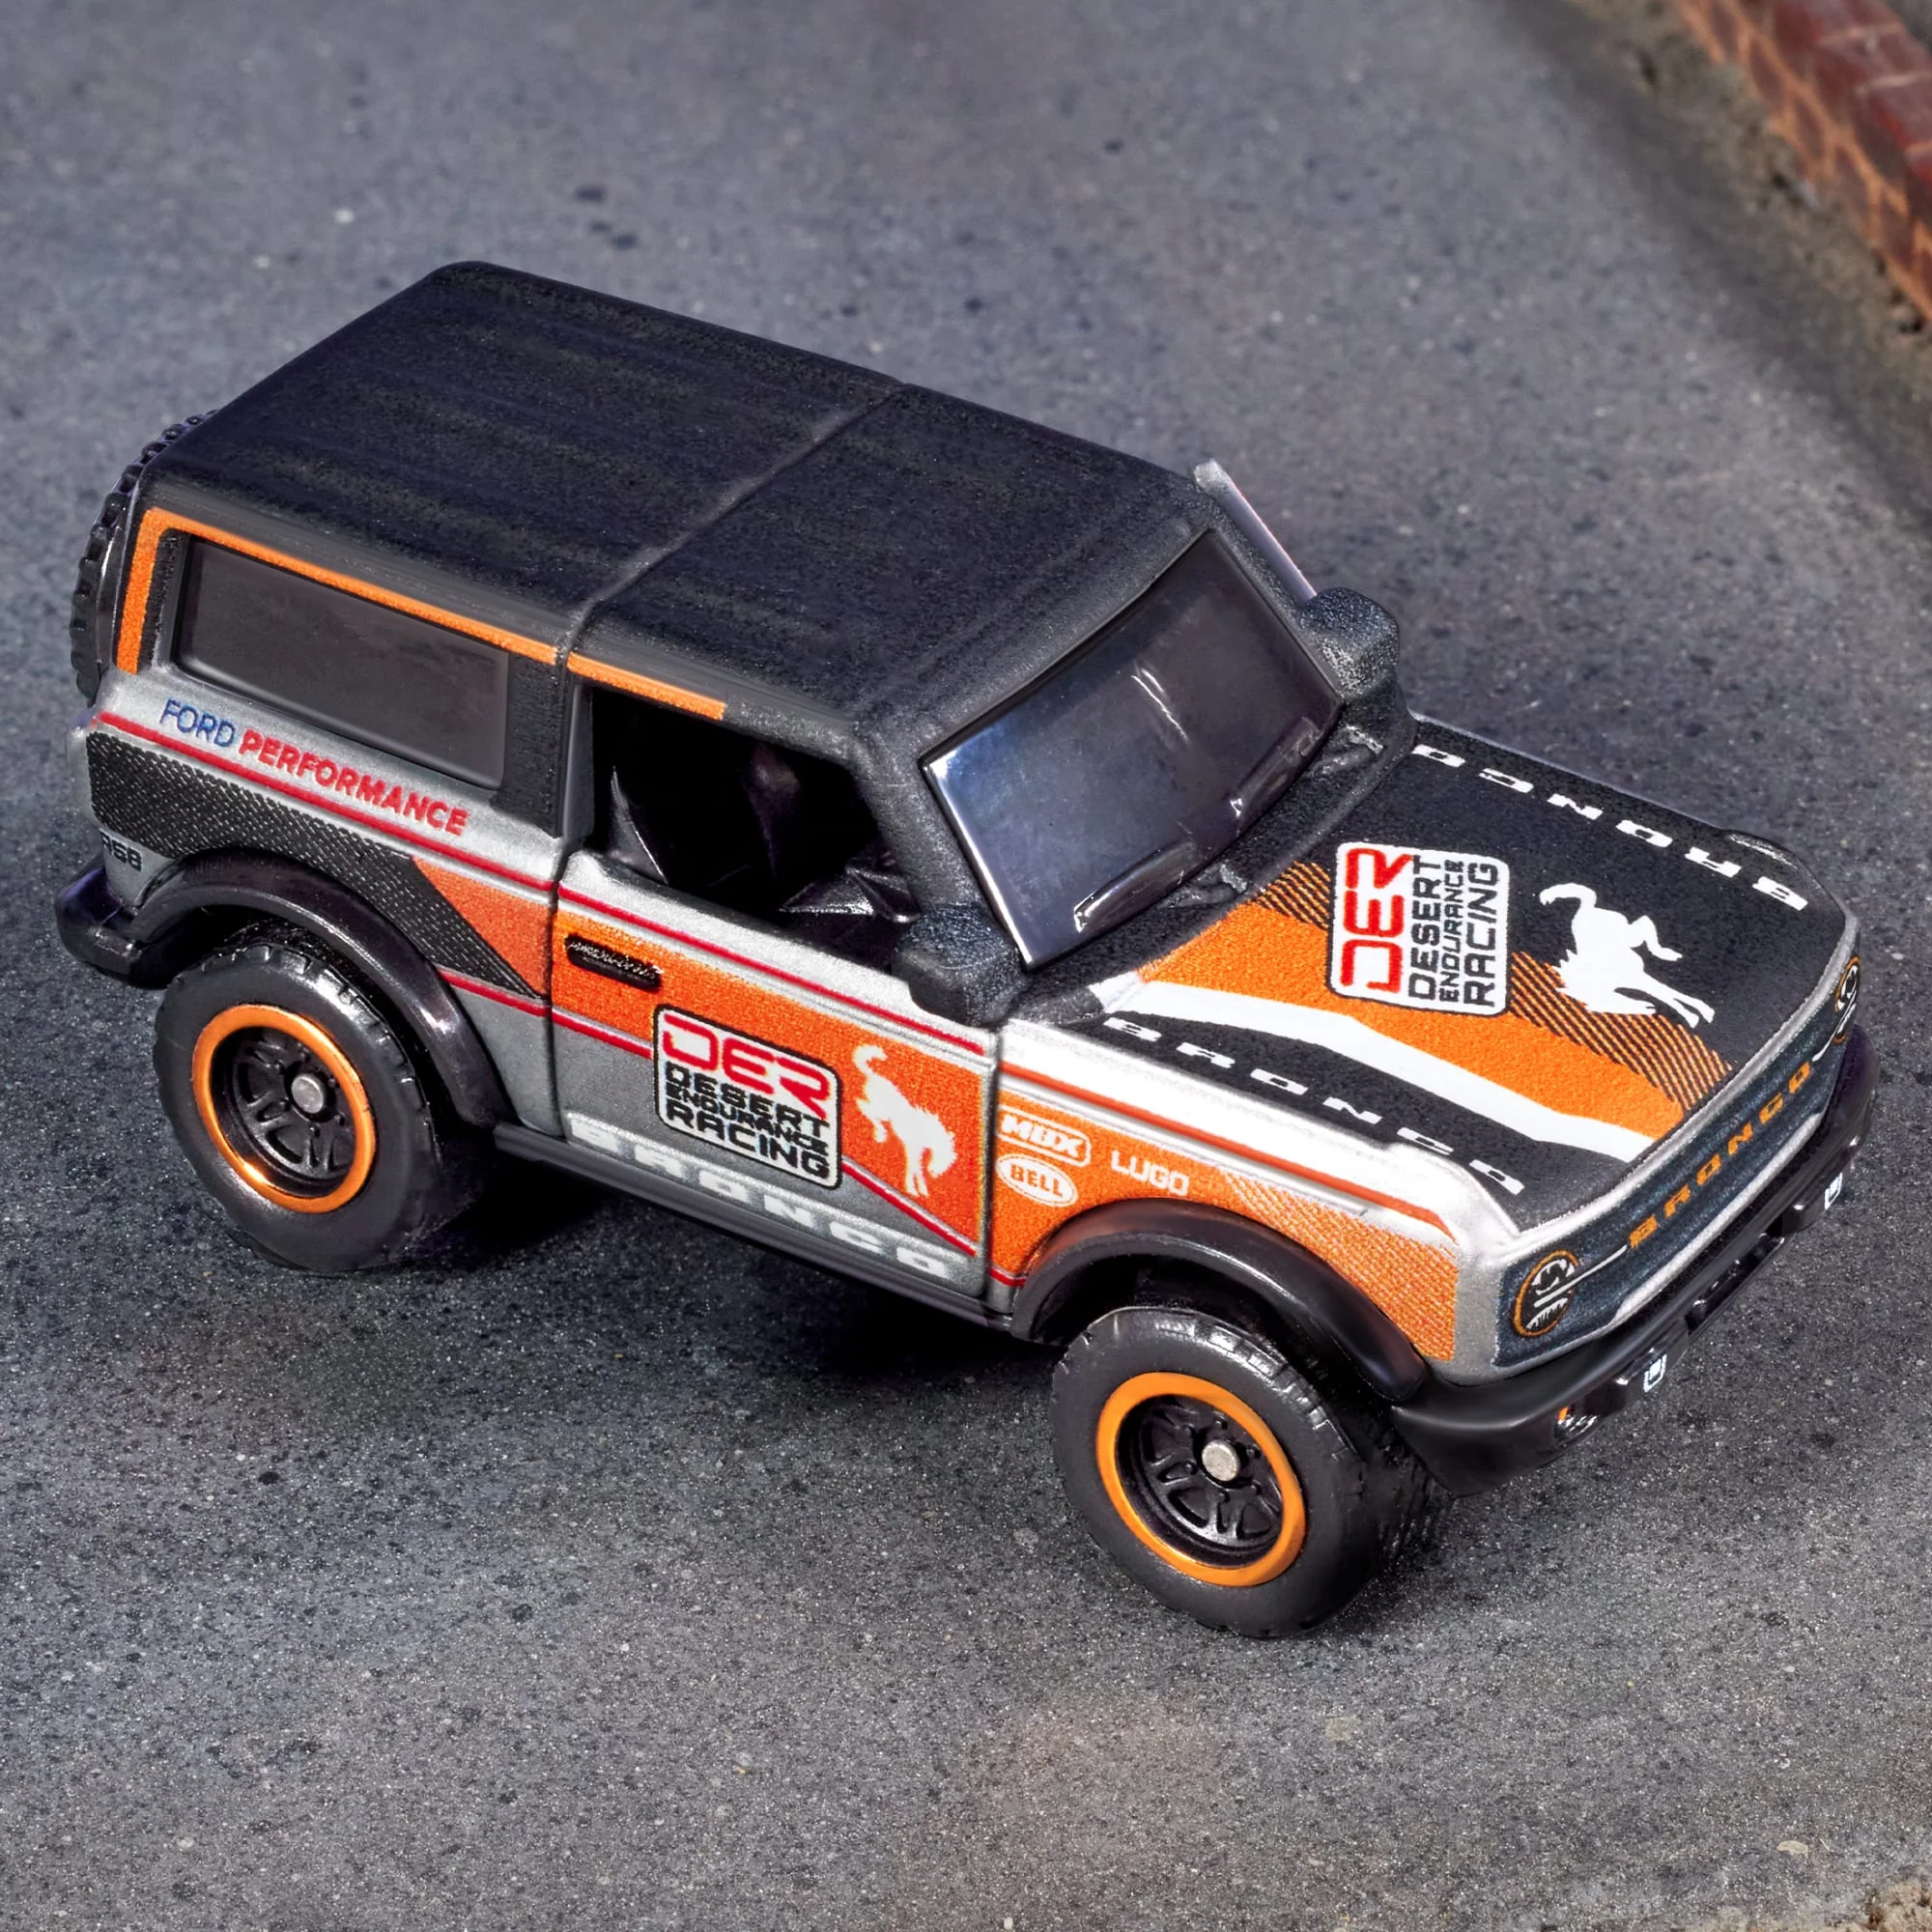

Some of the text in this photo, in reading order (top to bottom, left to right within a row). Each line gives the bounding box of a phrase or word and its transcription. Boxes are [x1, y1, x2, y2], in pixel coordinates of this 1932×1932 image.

[160, 696, 469, 837] FORD PERFORMANCE
[1411, 744, 1808, 912] BRONCO
[1340, 847, 1414, 994] DER
[1407, 855, 1442, 1001] DESERT
[1438, 860, 1464, 1003] ENDURANCE
[1463, 862, 1499, 1008] RACING
[663, 1013, 831, 1121] DER
[666, 1061, 830, 1138] DESERT
[666, 1081, 830, 1157] ENDURANCE
[666, 1098, 831, 1179] RACING
[1103, 1017, 1525, 1196] BRONCO
[570, 1117, 950, 1280] BRONCO
[1009, 1163, 1064, 1198] BELL
[1111, 1150, 1190, 1197] LUGO
[1629, 1062, 1811, 1248] BRONCO
